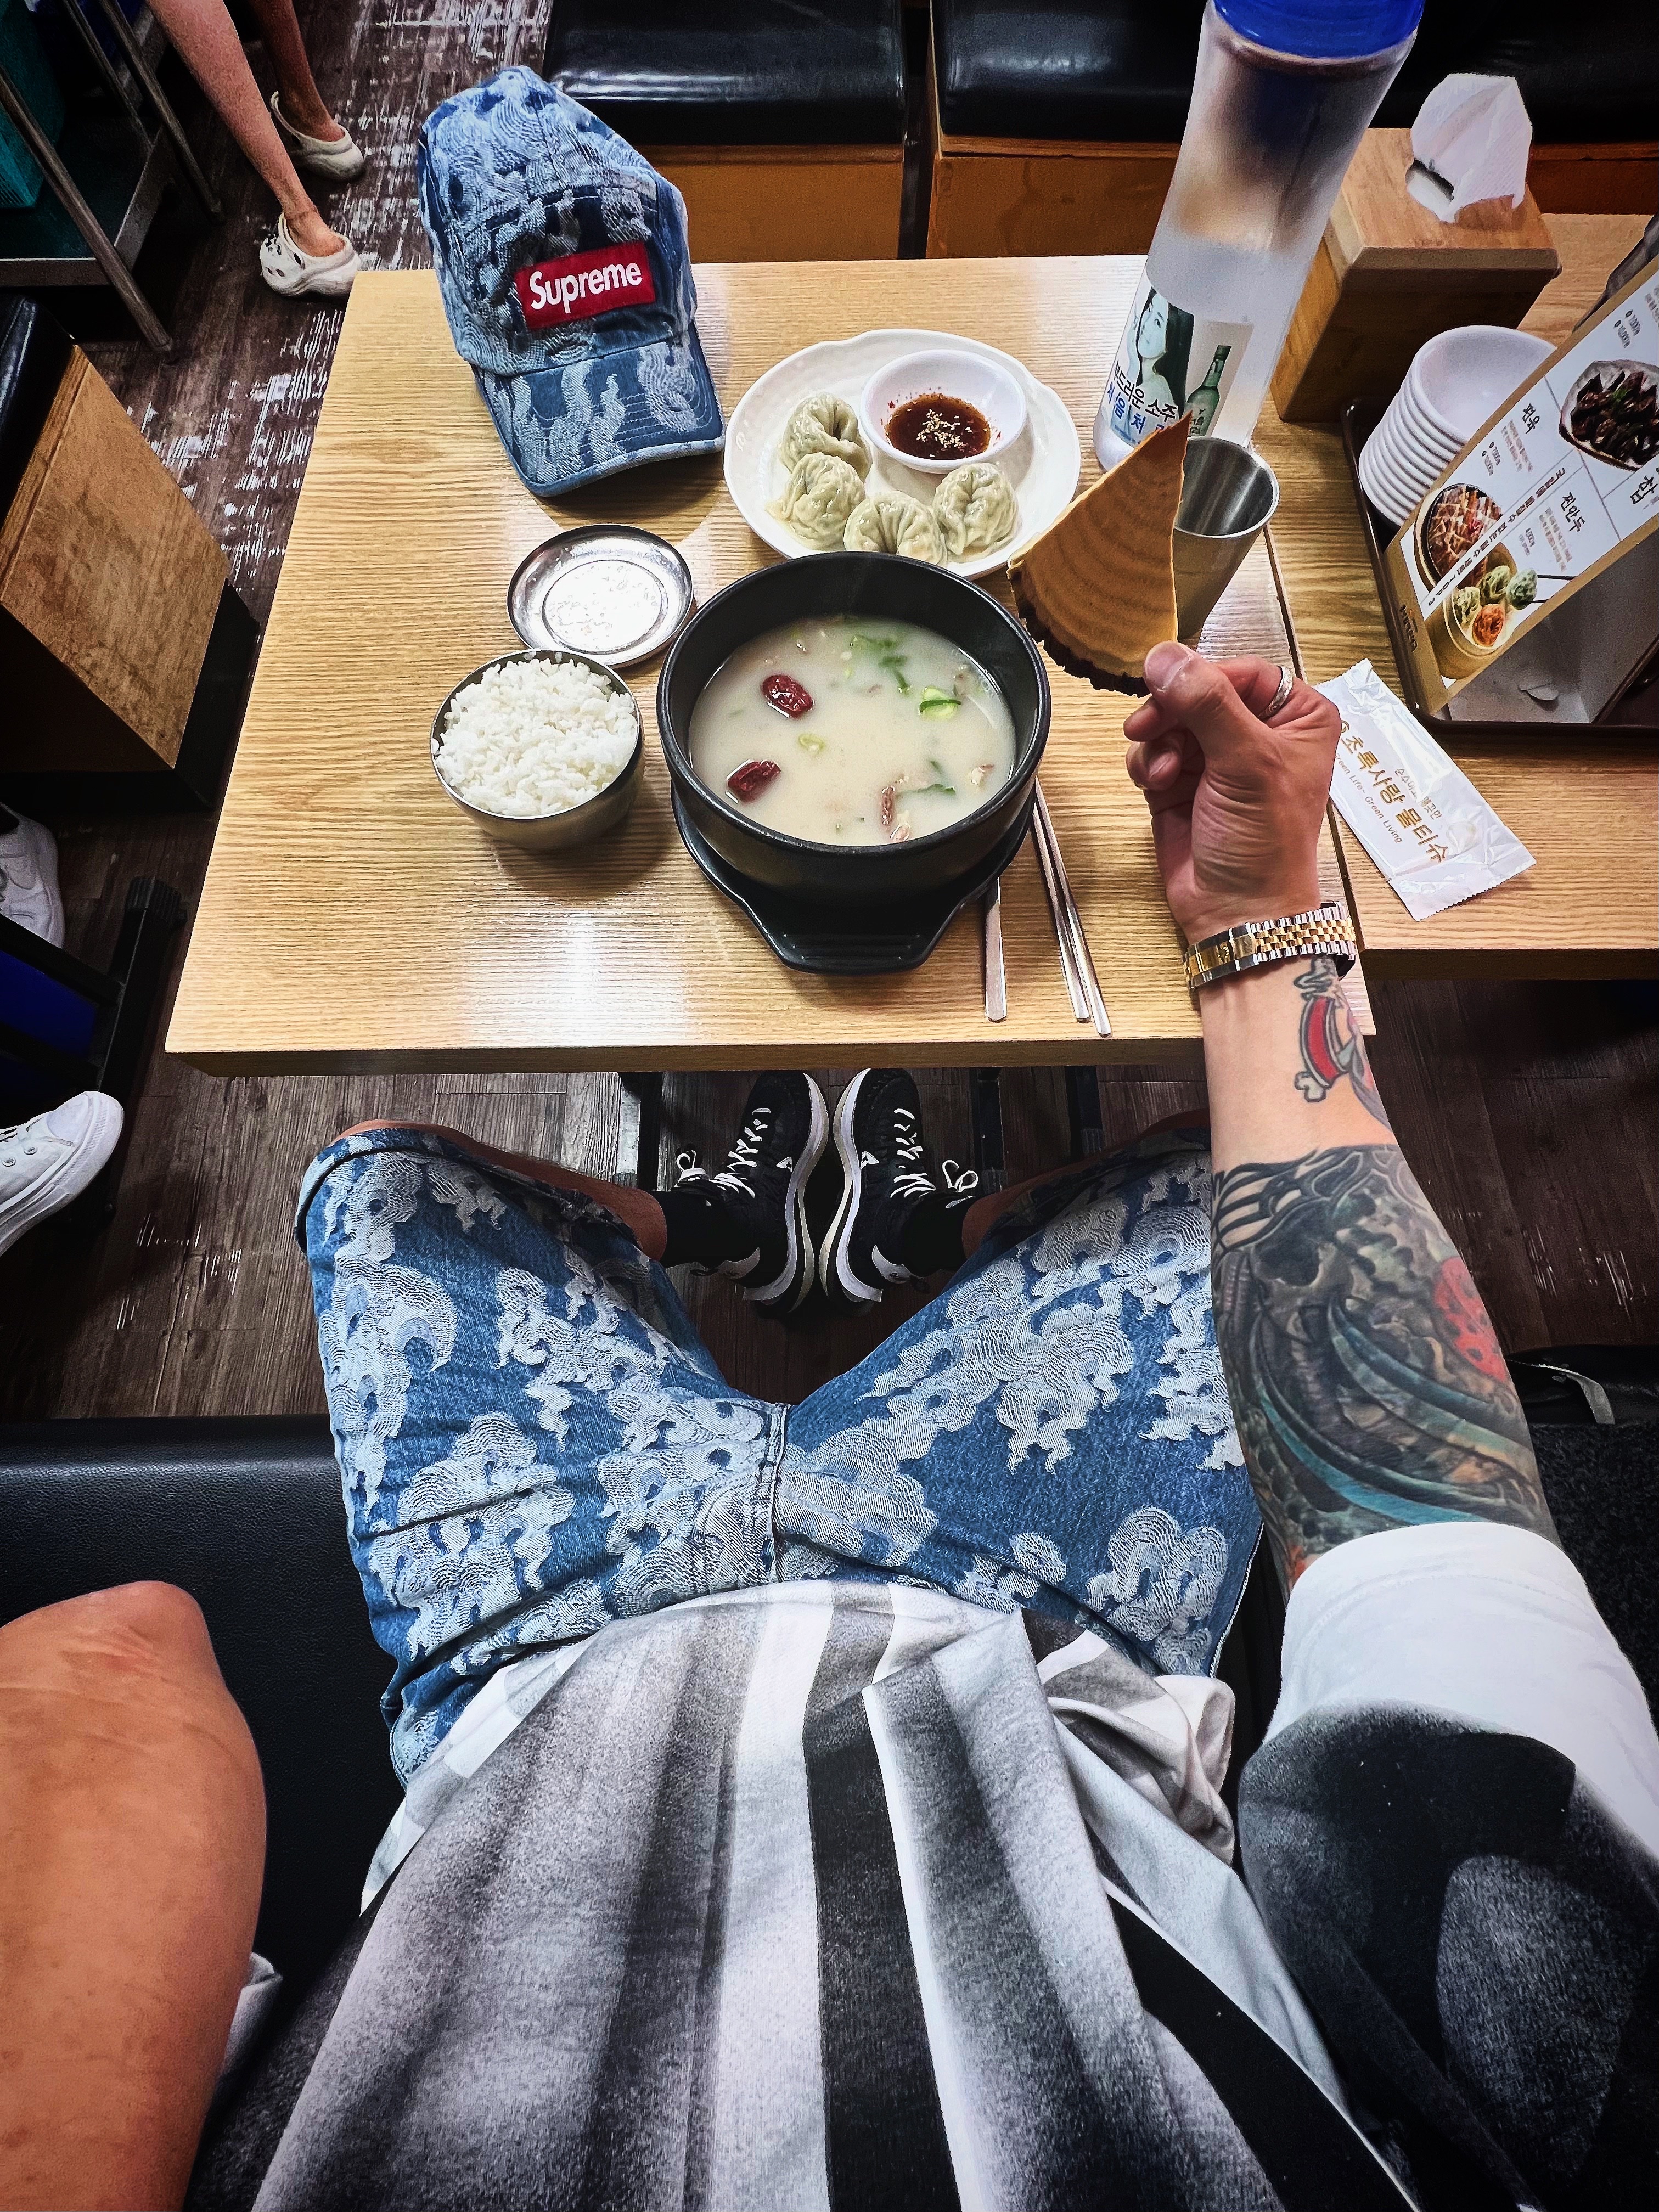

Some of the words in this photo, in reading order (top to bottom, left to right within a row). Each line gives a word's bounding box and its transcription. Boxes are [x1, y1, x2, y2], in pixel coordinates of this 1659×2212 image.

[530, 263, 642, 314] Supreme
[1114, 360, 1145, 409] 부드러운
[1145, 399, 1177, 422] 소주
[1522, 403, 1540, 434] 편육
[1560, 492, 1585, 532] 찐만두
[1341, 735, 1405, 804] 초록사랑
[1395, 808, 1448, 863] 물티슈
[1365, 796, 1385, 819] Green
[1382, 820, 1403, 843] Living
